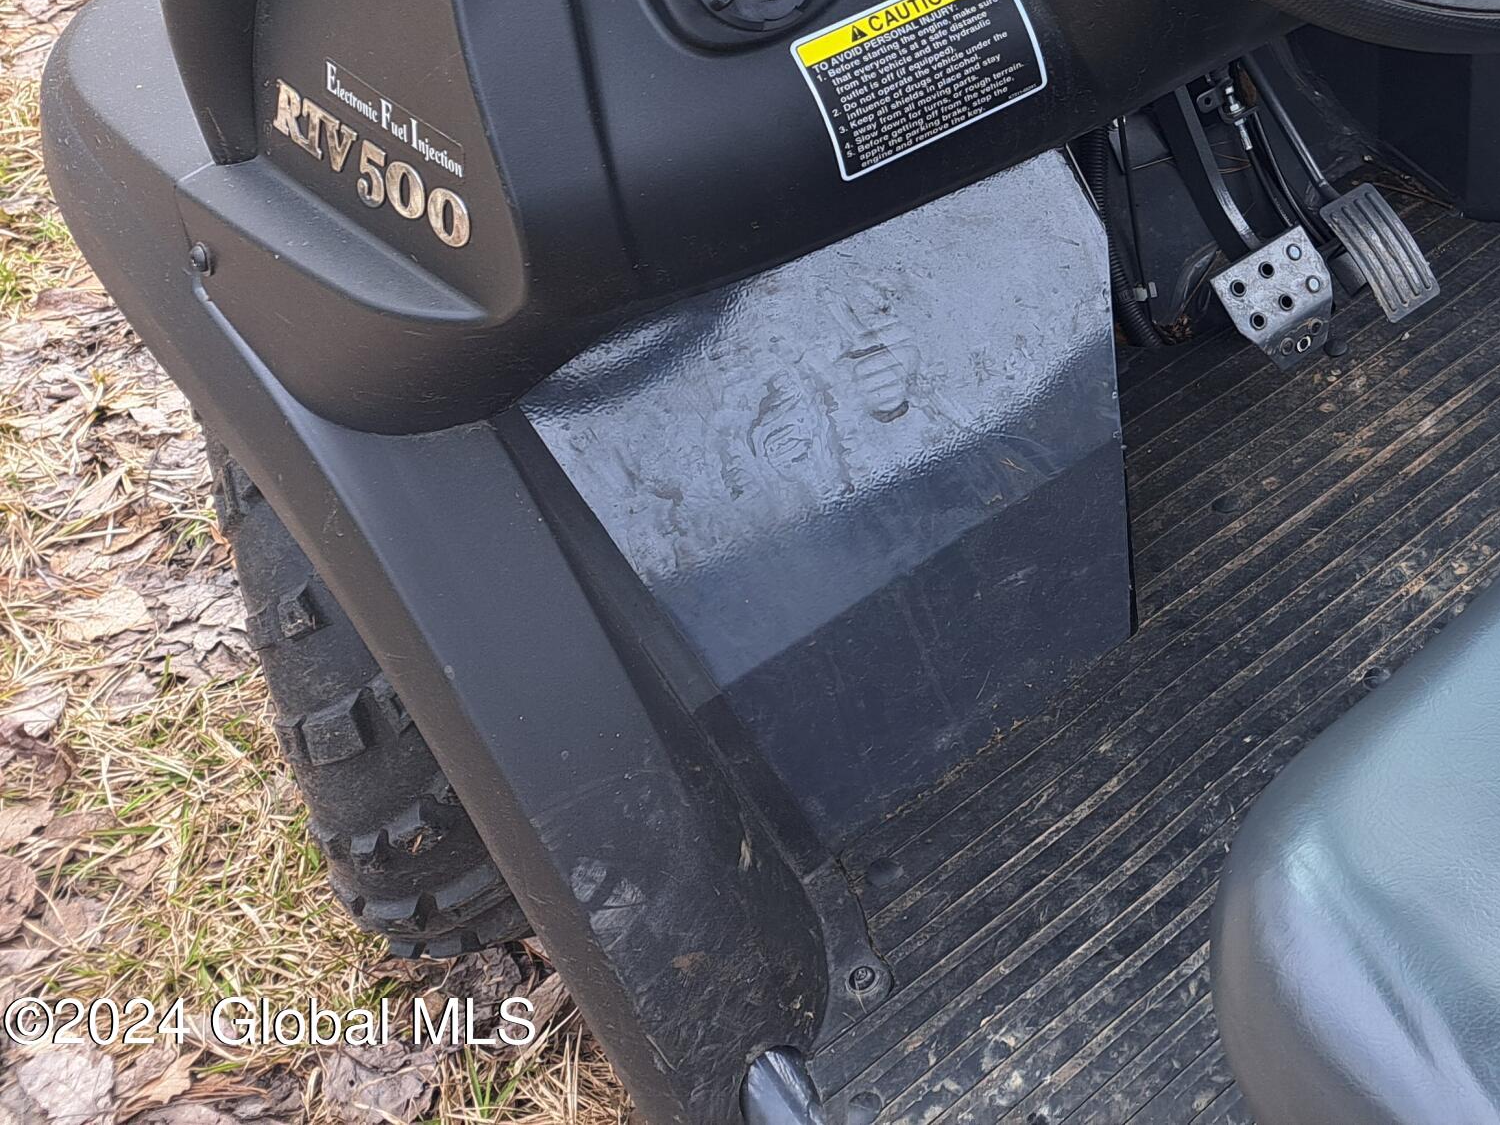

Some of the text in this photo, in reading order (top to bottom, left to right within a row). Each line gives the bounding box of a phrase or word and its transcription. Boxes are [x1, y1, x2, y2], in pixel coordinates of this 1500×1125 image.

[812, 4, 957, 72] TO AVOID PERSONAL INJURY:
[827, 59, 859, 76] Before
[862, 41, 899, 61] starting
[900, 34, 915, 44] the
[917, 19, 950, 36] engine,
[952, 6, 976, 20] make
[832, 72, 851, 85] that
[854, 53, 896, 75] everyone
[898, 47, 907, 55] is
[909, 41, 918, 50] at
[928, 29, 947, 41] safe
[950, 11, 986, 31] distance
[832, 31, 1007, 116] 2. Do not operate the vehicle under the
[836, 19, 990, 94] from the vehicle and the hydraulic
[840, 46, 955, 102] outlet is off (if equipped).
[326, 61, 464, 178] Electronic Fuel Injection
[847, 53, 980, 119] influence of drugs or alcohol.
[849, 113, 874, 128] Keep
[877, 105, 888, 116] all
[890, 90, 923, 109] shields
[937, 72, 961, 88] place
[964, 62, 980, 74] and
[982, 54, 1000, 66] stay
[853, 75, 978, 136] away from all moving parts.
[855, 129, 877, 144] Slow
[881, 117, 906, 132] down
[908, 109, 921, 119] for
[924, 97, 950, 112] turns,
[953, 90, 962, 98] or
[965, 77, 990, 92] rough
[992, 62, 1023, 79] terrain.
[857, 134, 888, 152] Before
[891, 118, 923, 137] getting
[926, 109, 938, 120] off
[940, 100, 961, 112] from
[964, 92, 978, 101] the
[980, 76, 1014, 93] vehicle,
[860, 144, 884, 159] apply
[888, 136, 902, 146] the
[905, 119, 940, 139] parking
[942, 106, 969, 120] brake,
[972, 94, 991, 106] stop
[993, 86, 1007, 96] the
[861, 106, 985, 169] engine and remove the key.
